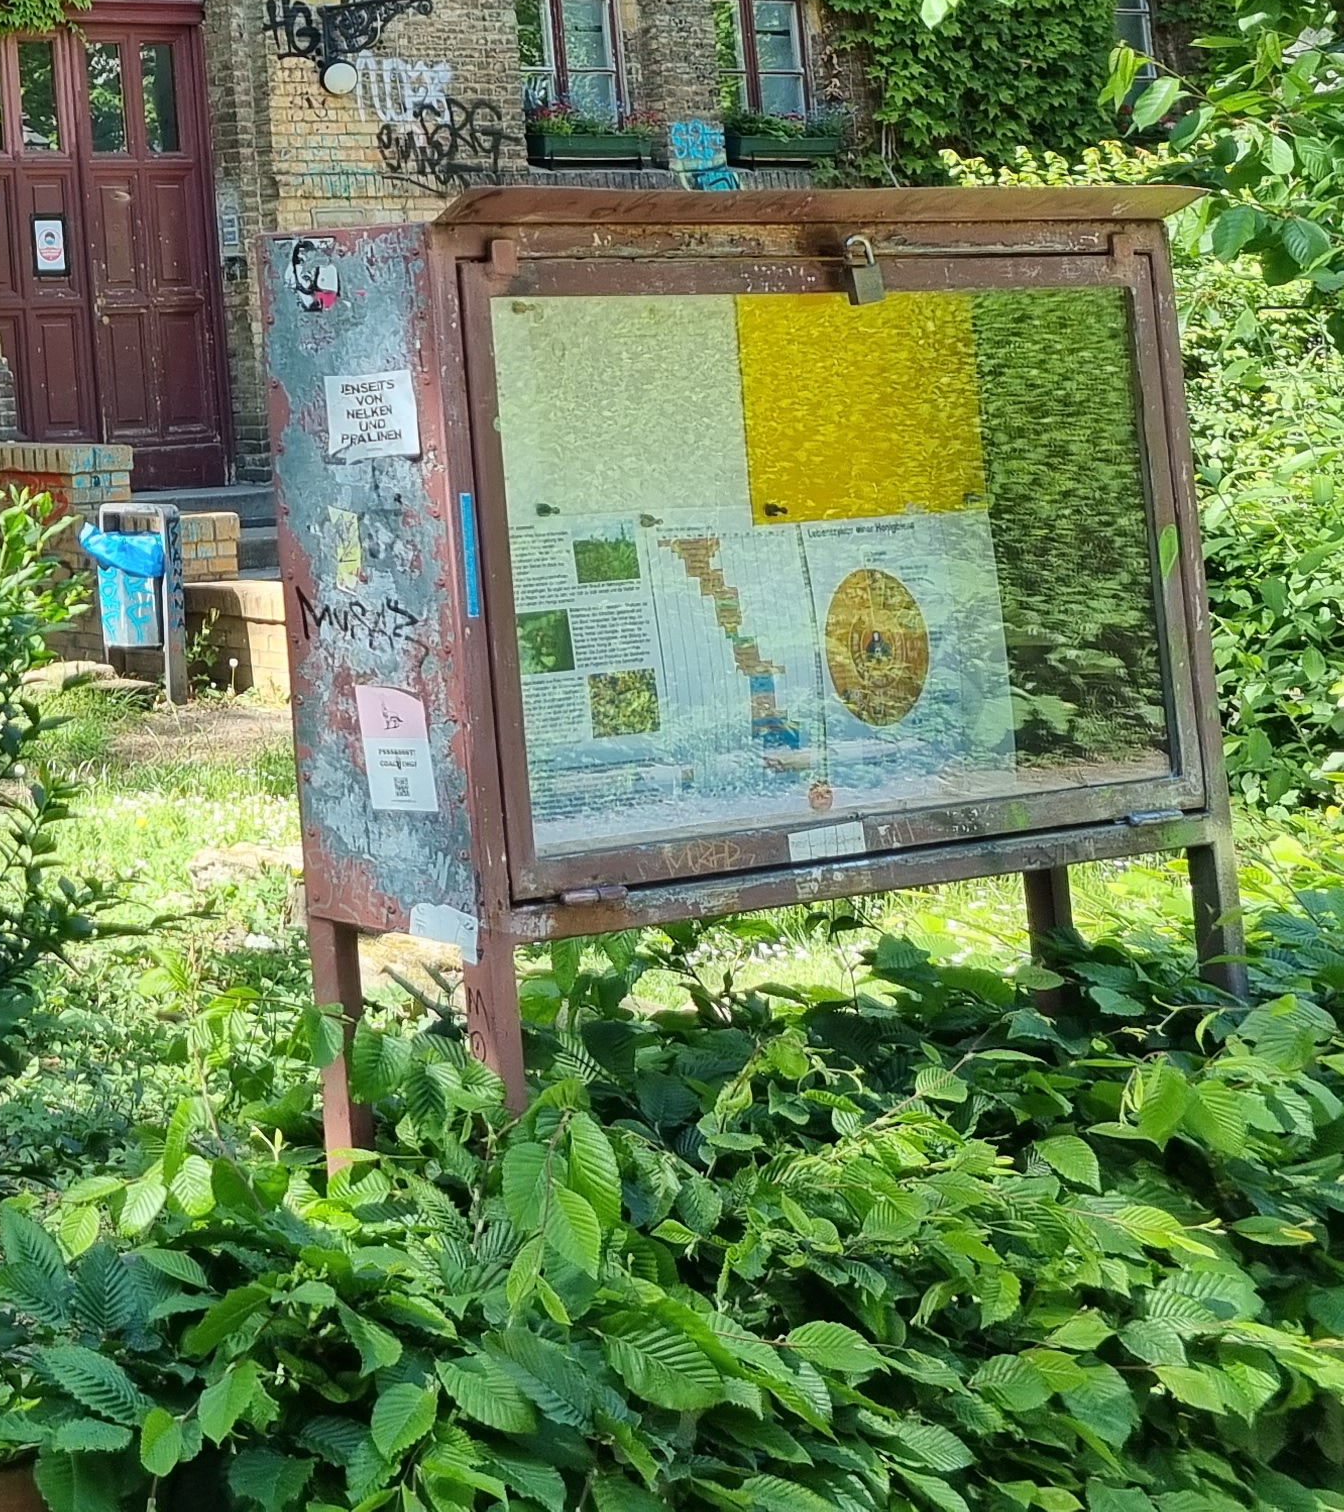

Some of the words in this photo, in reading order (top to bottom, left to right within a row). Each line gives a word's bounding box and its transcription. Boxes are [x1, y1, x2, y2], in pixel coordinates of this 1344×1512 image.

[341, 379, 395, 395] JENSEITS
[355, 394, 383, 406] VON
[346, 404, 393, 419] NELKEN
[359, 418, 386, 432] UND
[341, 429, 402, 445] PRALINEN
